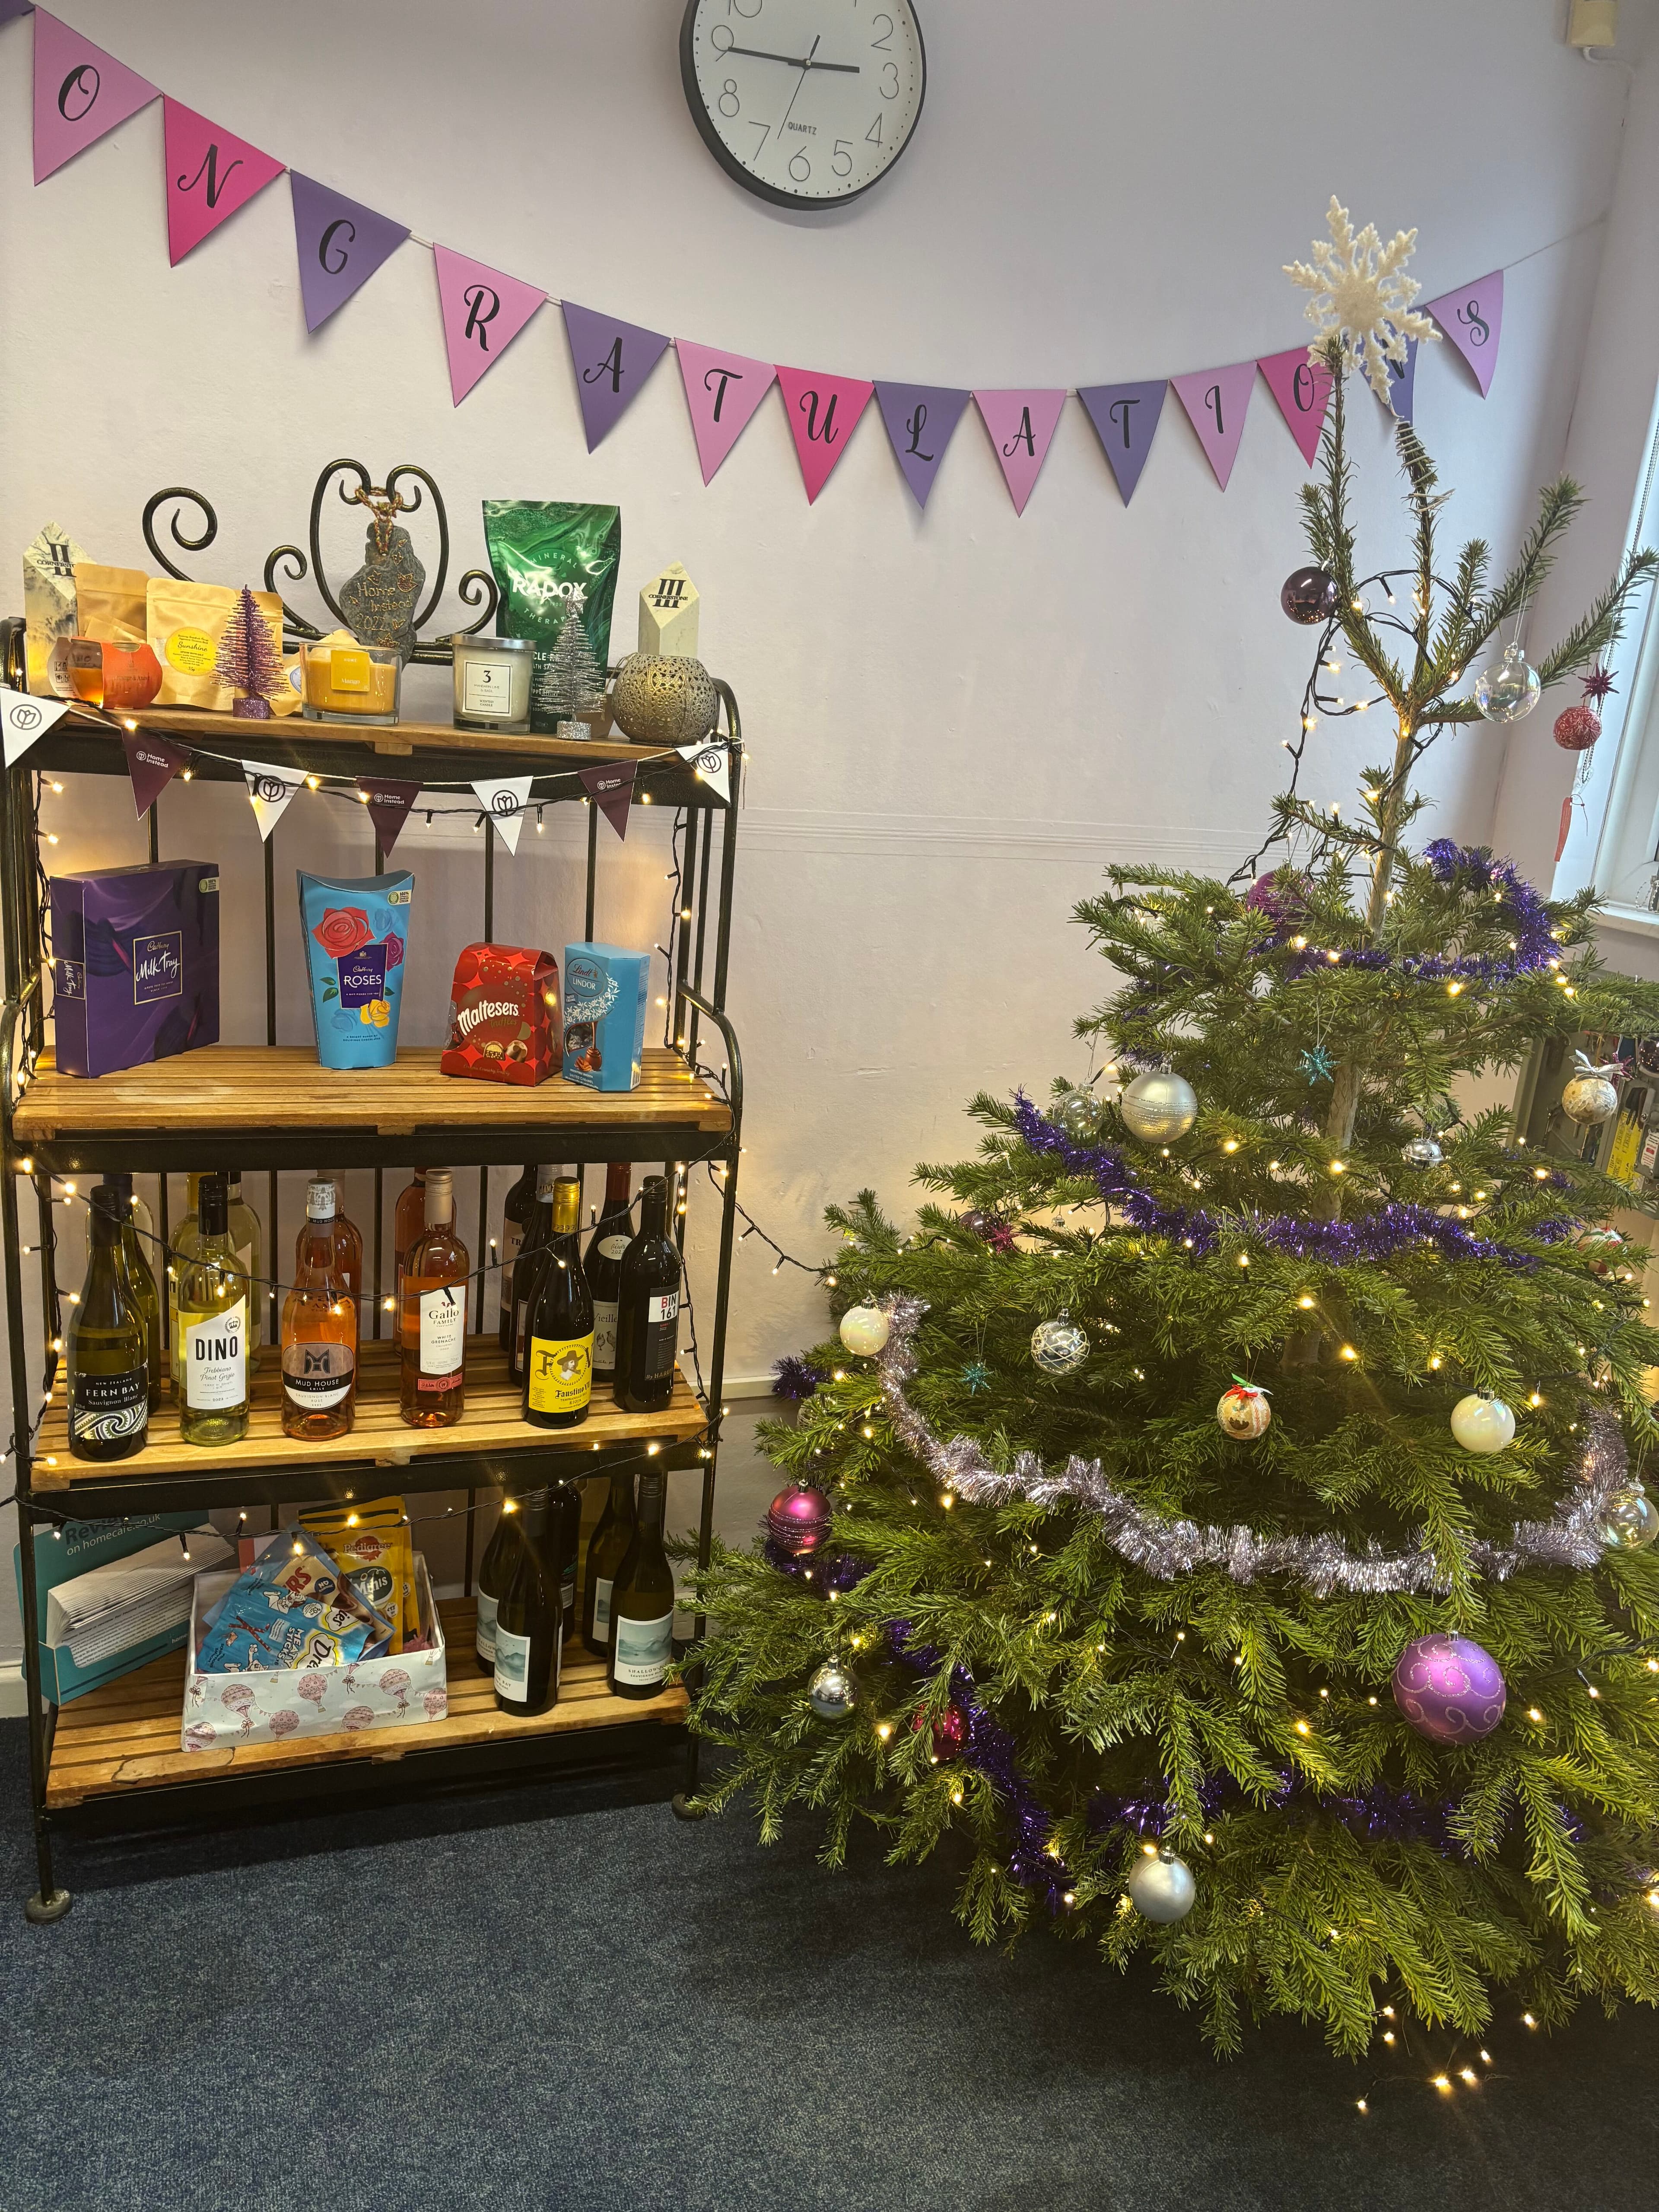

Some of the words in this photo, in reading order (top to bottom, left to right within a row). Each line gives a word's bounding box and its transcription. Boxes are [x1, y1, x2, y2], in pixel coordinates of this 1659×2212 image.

[871, 14, 893, 51] 2
[712, 25, 734, 61] 9
[880, 63, 899, 99] 3
[718, 79, 740, 117] 8
[788, 122, 817, 135] QUARTZ
[865, 113, 883, 147] 4
[748, 121, 771, 161] 7
[789, 146, 810, 181] 6
[832, 140, 853, 176] 5
[37, 560, 76, 568] CORNERST
[530, 552, 578, 569] MINERAL
[357, 582, 396, 597] Home
[512, 578, 587, 597] RADOX
[370, 594, 413, 612] Instead
[356, 613, 389, 631] 2022
[178, 641, 208, 652] Sunshine
[532, 652, 547, 661] CLE
[483, 670, 491, 683] 3
[146, 758, 169, 768] Instead
[147, 753, 165, 763] Home
[147, 941, 169, 952] Cadbury
[136, 957, 161, 982] Milk
[159, 950, 181, 979] Tray
[572, 964, 593, 976] Lindt
[343, 975, 382, 988] ROSES
[573, 977, 596, 991] LINDOR
[511, 1237, 521, 1246] TR
[661, 1294, 677, 1309] BIN
[429, 1308, 459, 1320] Gallo
[661, 1305, 676, 1320] 161
[196, 1336, 238, 1361] DINO
[219, 1373, 235, 1382] Grigio
[86, 1389, 118, 1397] FERN
[122, 1382, 140, 1394] BAY
[555, 1387, 584, 1399] Faustino
[124, 1394, 139, 1403] Blanc
[67, 1545, 80, 1556] on
[343, 1542, 391, 1553] Pedigree
[286, 1567, 311, 1593] RS
[332, 1610, 350, 1627] ies
[277, 1627, 296, 1660] STICKS
[283, 1628, 305, 1669] MEATY
